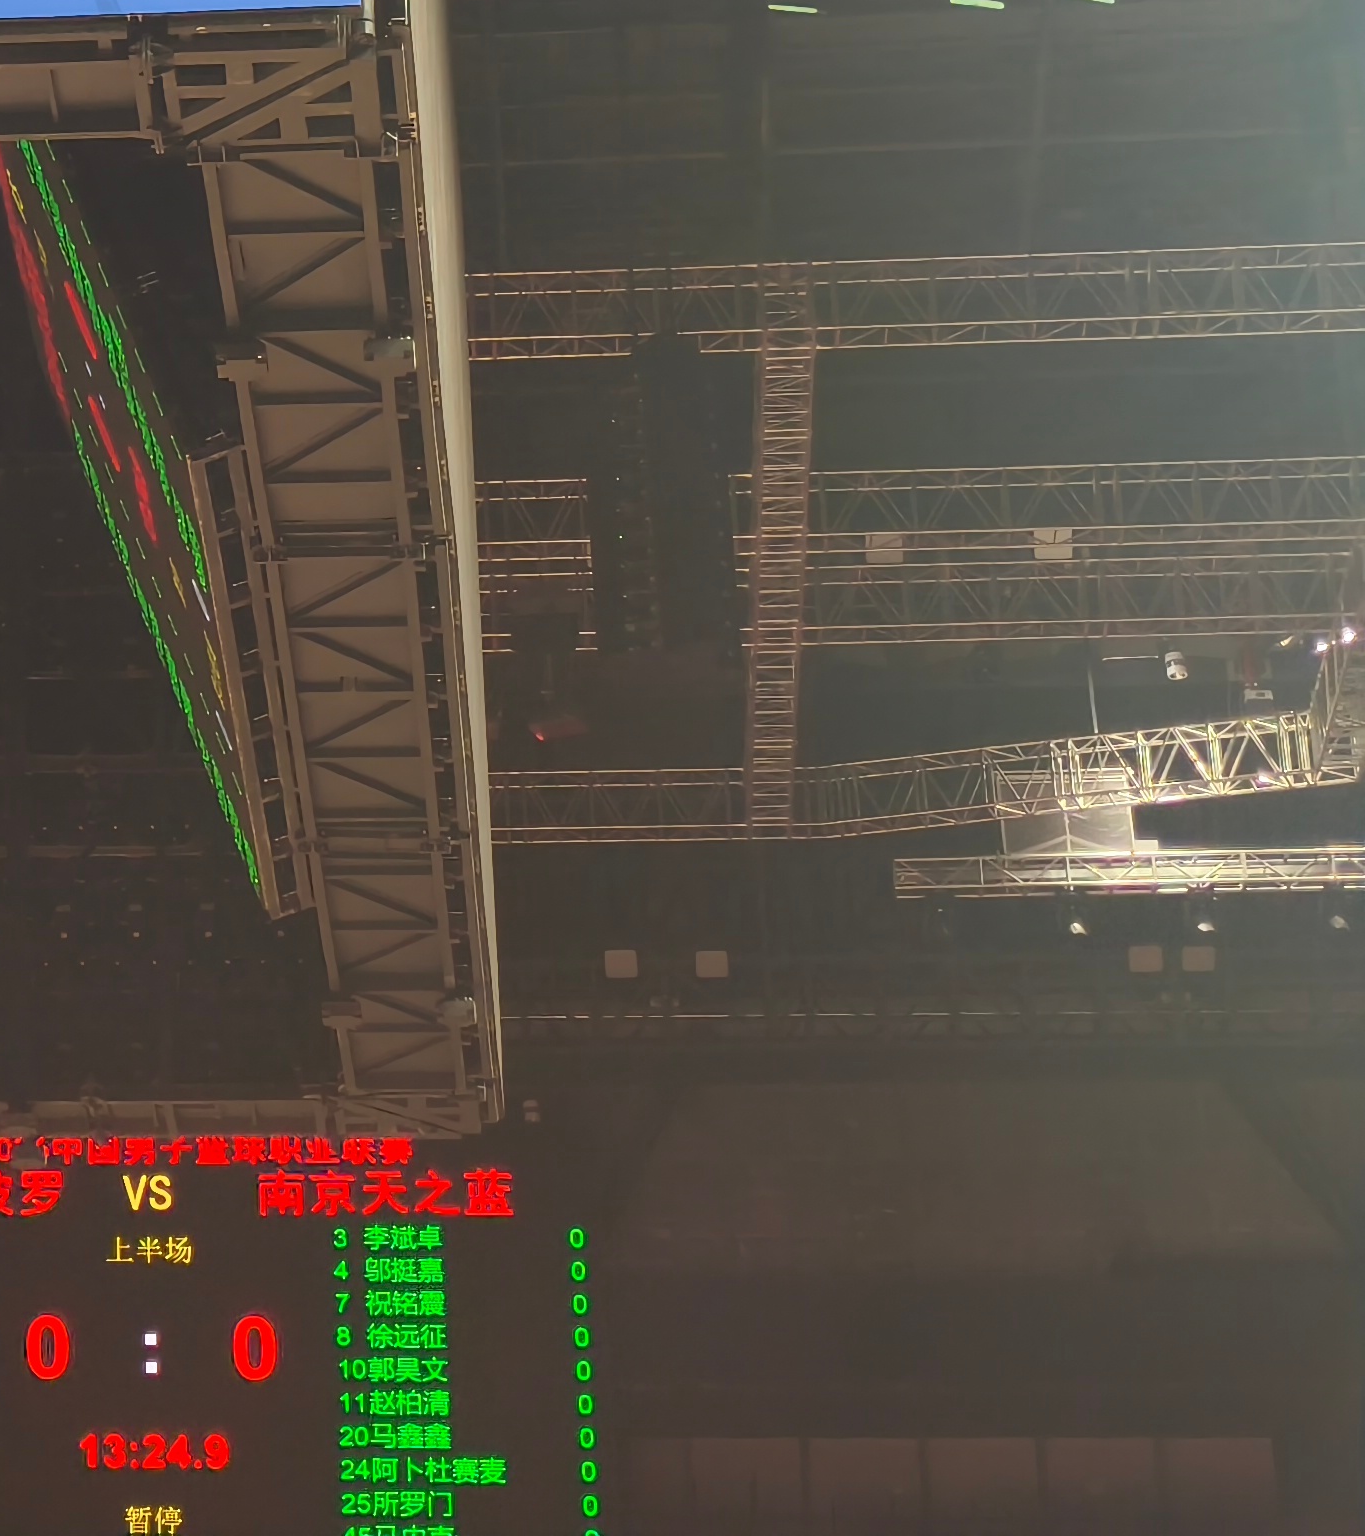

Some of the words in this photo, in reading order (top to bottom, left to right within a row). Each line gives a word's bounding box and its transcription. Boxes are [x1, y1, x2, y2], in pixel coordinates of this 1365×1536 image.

[122, 1174, 172, 1211] VS
[258, 1167, 515, 1218] 南京天之蓝
[105, 1236, 192, 1264] 上半场
[334, 1228, 348, 1249] 3
[363, 1224, 444, 1251] 李斌卓
[569, 1228, 584, 1249] 0
[333, 1260, 349, 1280] 4
[571, 1260, 586, 1281] 0
[335, 1293, 351, 1314] 7
[365, 1289, 446, 1317] 祝铭震
[572, 1294, 588, 1315] 0
[26, 1314, 70, 1380] 0
[232, 1315, 279, 1382] 0
[336, 1326, 351, 1347] 8
[366, 1322, 448, 1349] 徐远征
[574, 1326, 590, 1348] 0
[576, 1360, 592, 1381] 0
[340, 1389, 451, 1417] 11赵柏清
[578, 1394, 594, 1415] 0
[339, 1422, 452, 1450] 20马鑫鑫
[579, 1427, 595, 1449] 0
[79, 1433, 230, 1470] 13:24.9
[340, 1456, 507, 1485] 24阿卜杜赛麦
[581, 1461, 597, 1483] 0
[341, 1490, 453, 1518] 25所罗门
[582, 1495, 598, 1517] 0
[125, 1506, 183, 1536] 暂停
